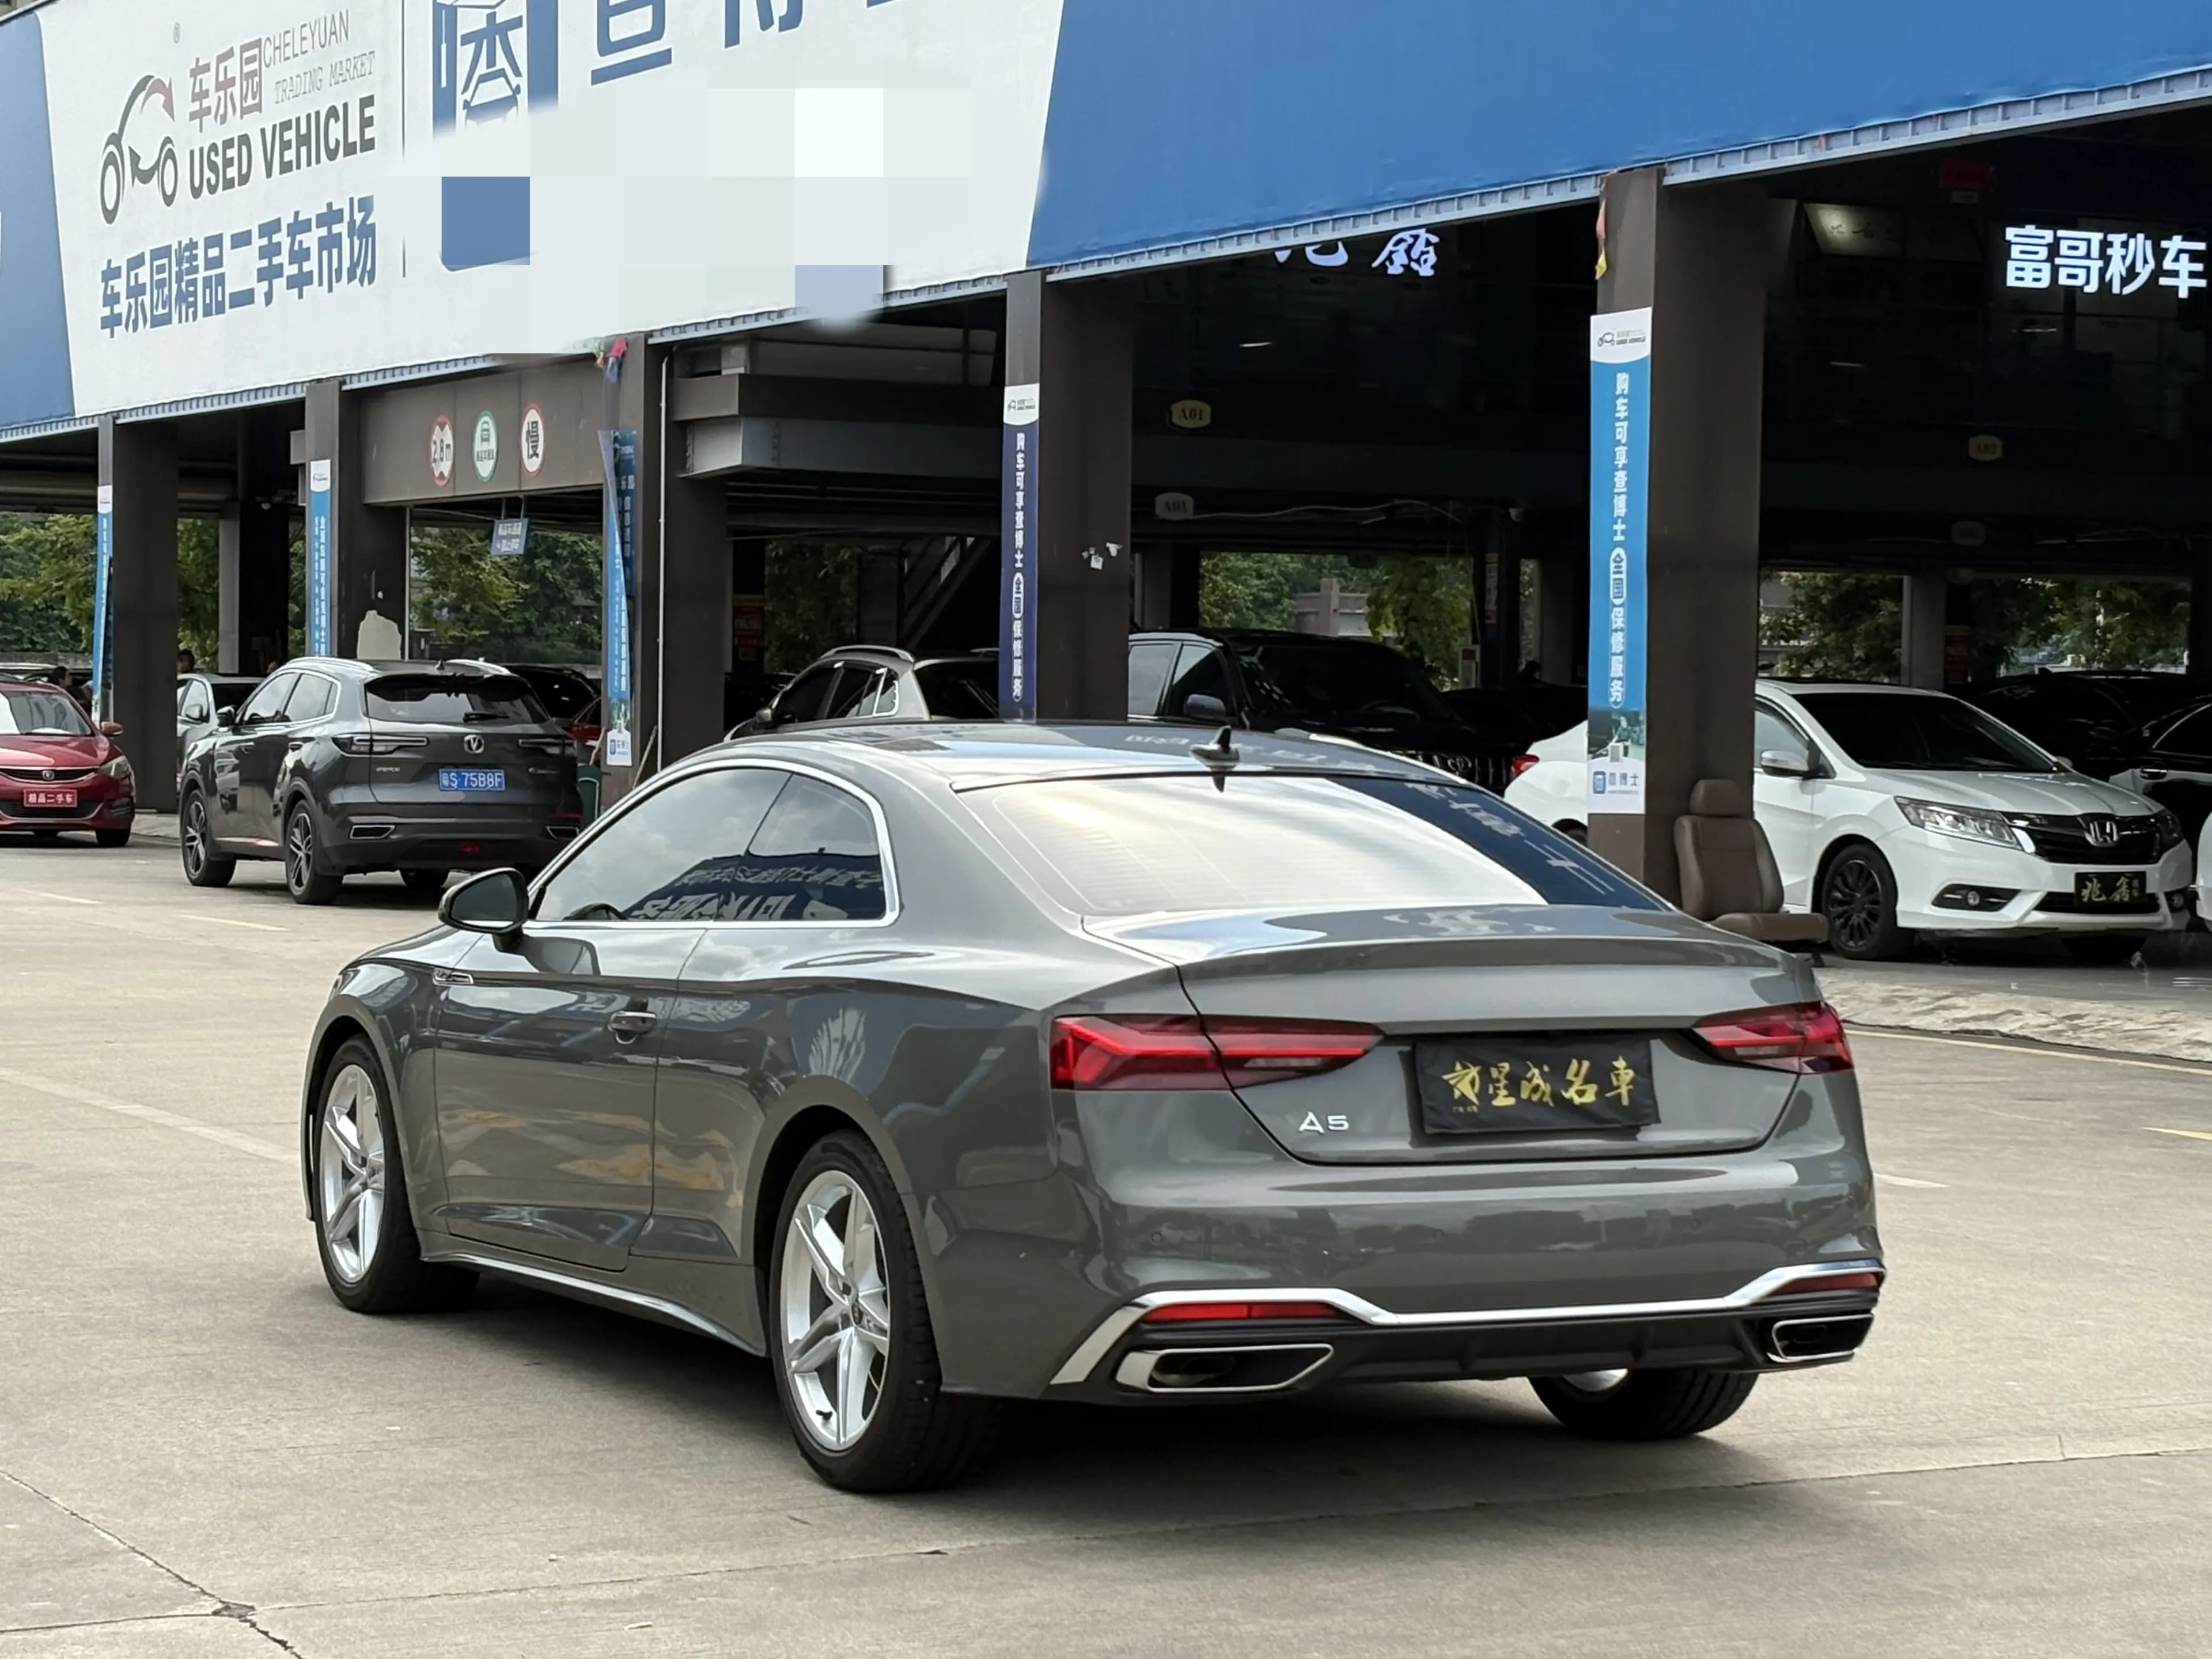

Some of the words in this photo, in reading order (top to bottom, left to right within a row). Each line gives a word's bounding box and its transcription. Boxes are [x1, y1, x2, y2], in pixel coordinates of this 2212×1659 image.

[263, 9, 349, 69] CHELEYUAN
[189, 37, 262, 133] 车乐园
[274, 66, 323, 104] TRADING
[329, 50, 376, 87] MARKET
[189, 133, 252, 199] USED
[260, 94, 376, 179] VEHICLE
[100, 195, 377, 339] 车乐园精品二手车市场
[2005, 224, 2207, 299] 富哥秒车
[526, 421, 539, 459] 慢
[1298, 1111, 1350, 1134] A5
